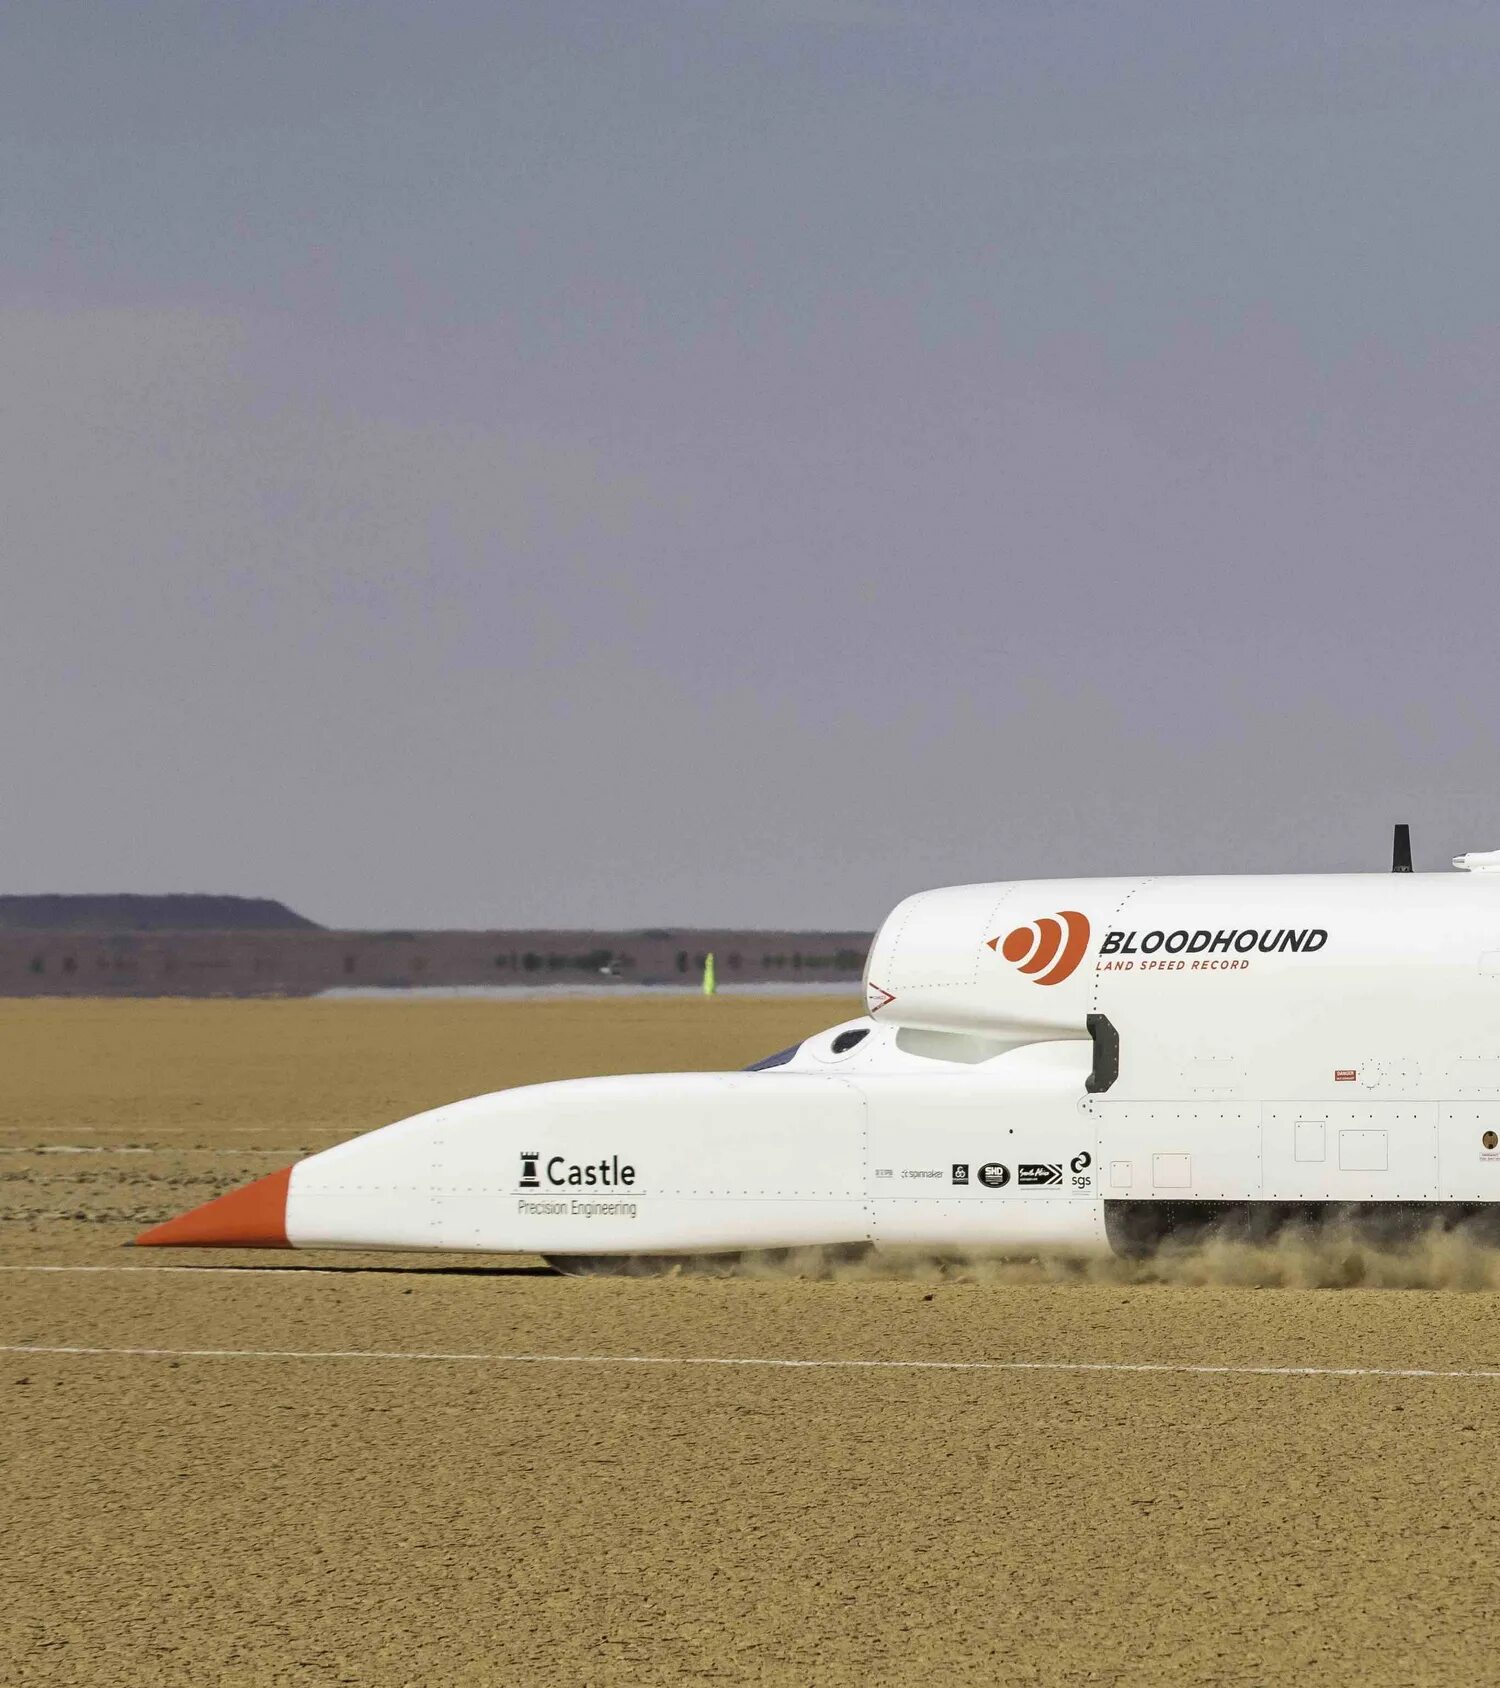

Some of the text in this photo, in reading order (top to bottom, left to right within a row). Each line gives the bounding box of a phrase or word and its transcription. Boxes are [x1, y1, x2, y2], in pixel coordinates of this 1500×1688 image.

[1098, 929, 1328, 954] BLOODHOUND
[1095, 959, 1249, 971] LAND SPEED RECORD
[547, 1155, 635, 1185] Castle
[985, 1167, 1003, 1175] SHD
[1072, 1176, 1091, 1189] sgs
[518, 1199, 637, 1218] Precision Engineering
